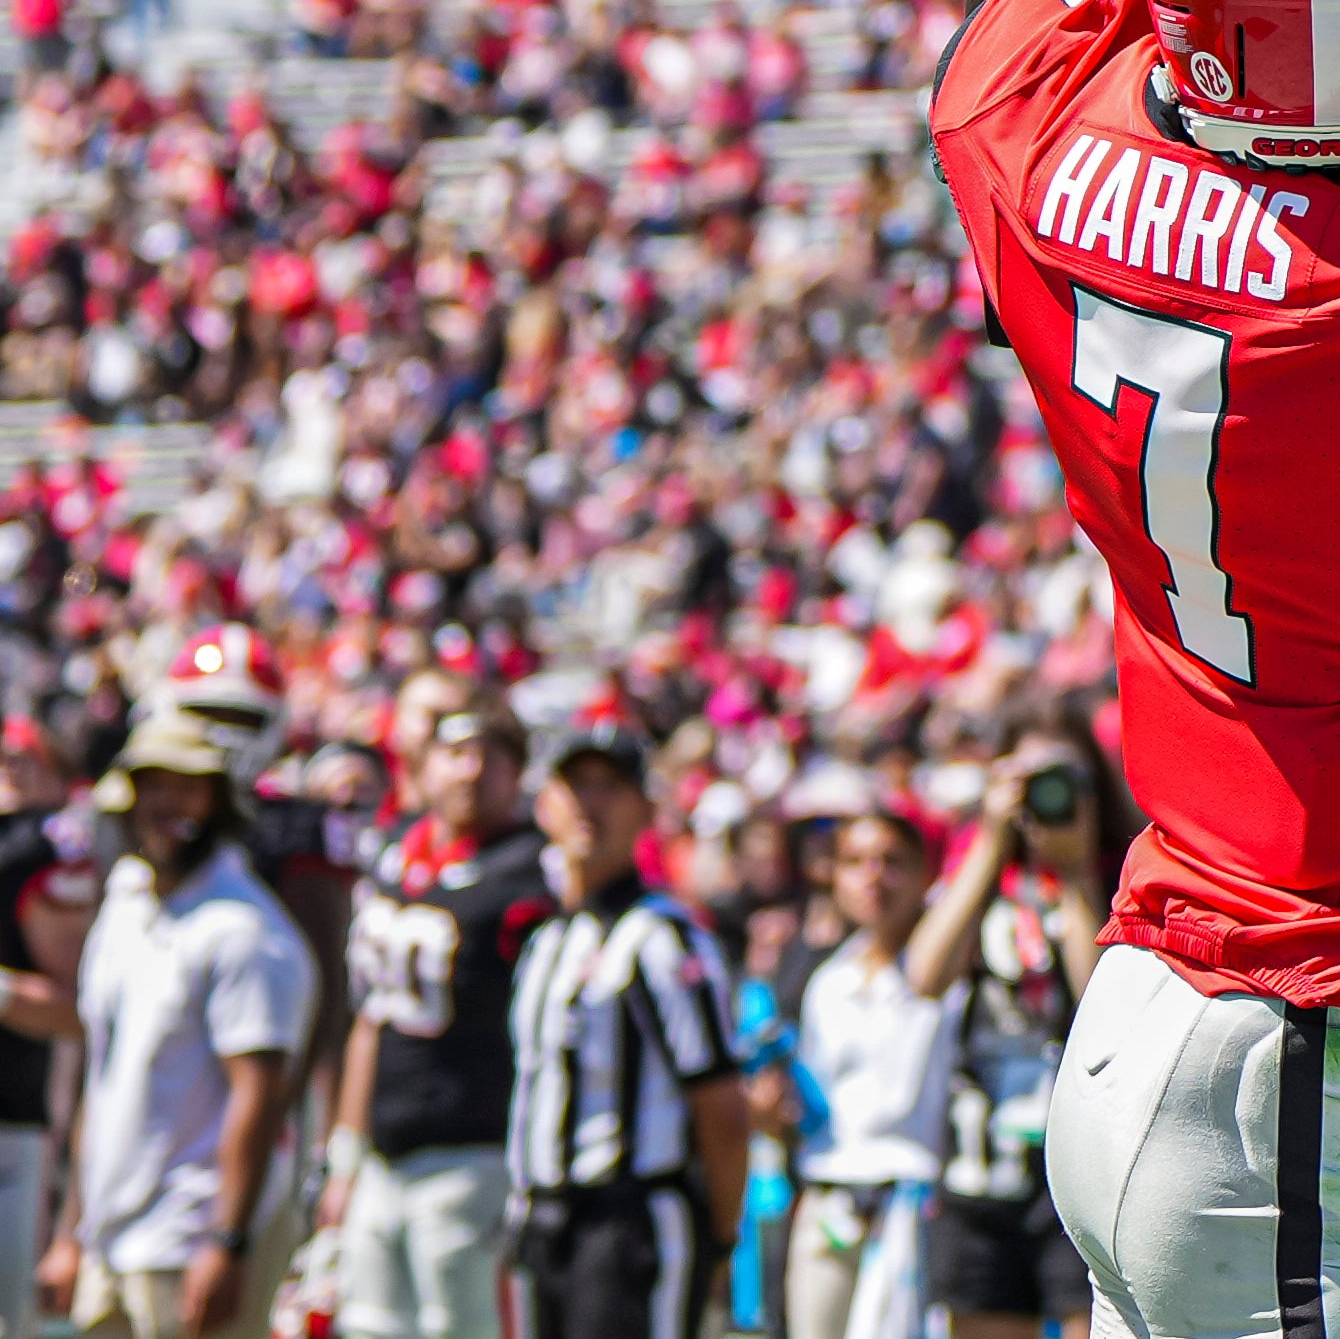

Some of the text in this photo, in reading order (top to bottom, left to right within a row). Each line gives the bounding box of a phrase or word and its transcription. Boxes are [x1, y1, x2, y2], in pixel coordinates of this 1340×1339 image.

[1194, 57, 1228, 97] SEC
[1036, 133, 1310, 301] HARRIS
[1068, 280, 1257, 690] 7
